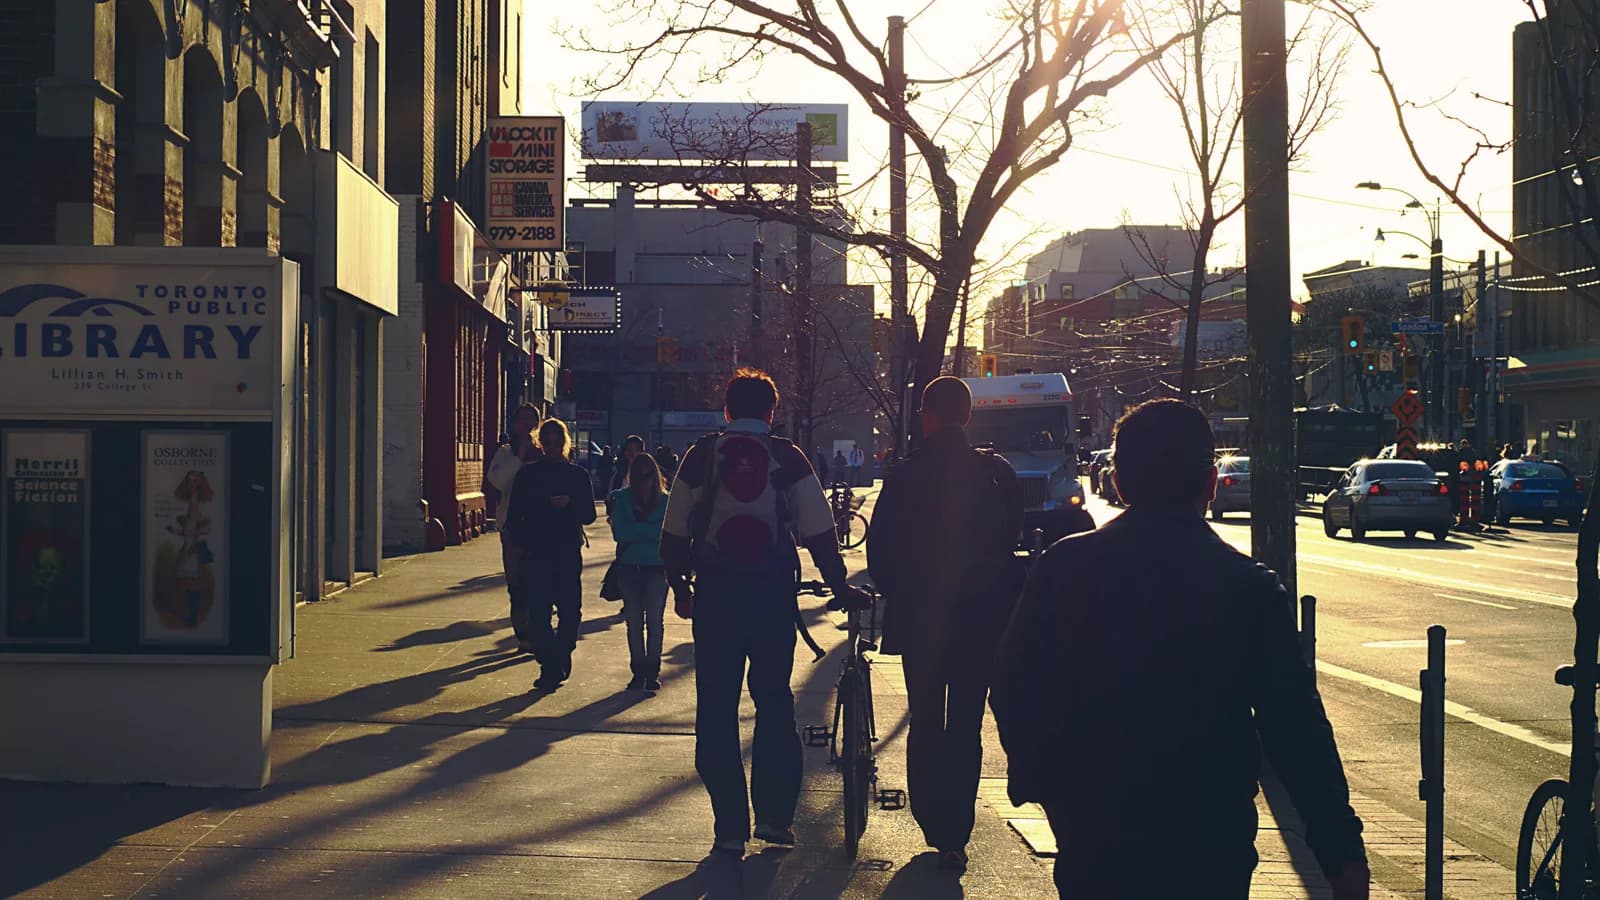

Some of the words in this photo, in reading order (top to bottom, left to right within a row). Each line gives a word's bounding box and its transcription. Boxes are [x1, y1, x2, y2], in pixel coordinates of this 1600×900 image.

[513, 143, 555, 157] MINI
[489, 159, 554, 174] STORAGE
[515, 182, 549, 193] CANADA
[515, 206, 555, 218] SERVICES
[489, 226, 555, 241] 979-2188
[135, 284, 267, 299] TORONTO
[168, 301, 267, 315] PUBLIC
[0, 323, 263, 360] IBRARY
[51, 368, 105, 380] Lillian
[136, 368, 183, 380] Smith
[96, 382, 137, 392] College
[153, 447, 217, 458] OSBORNE
[15, 458, 78, 469] Merril
[153, 458, 217, 466] COLLECTION
[15, 479, 78, 490] Science
[15, 491, 78, 502] Fiction
